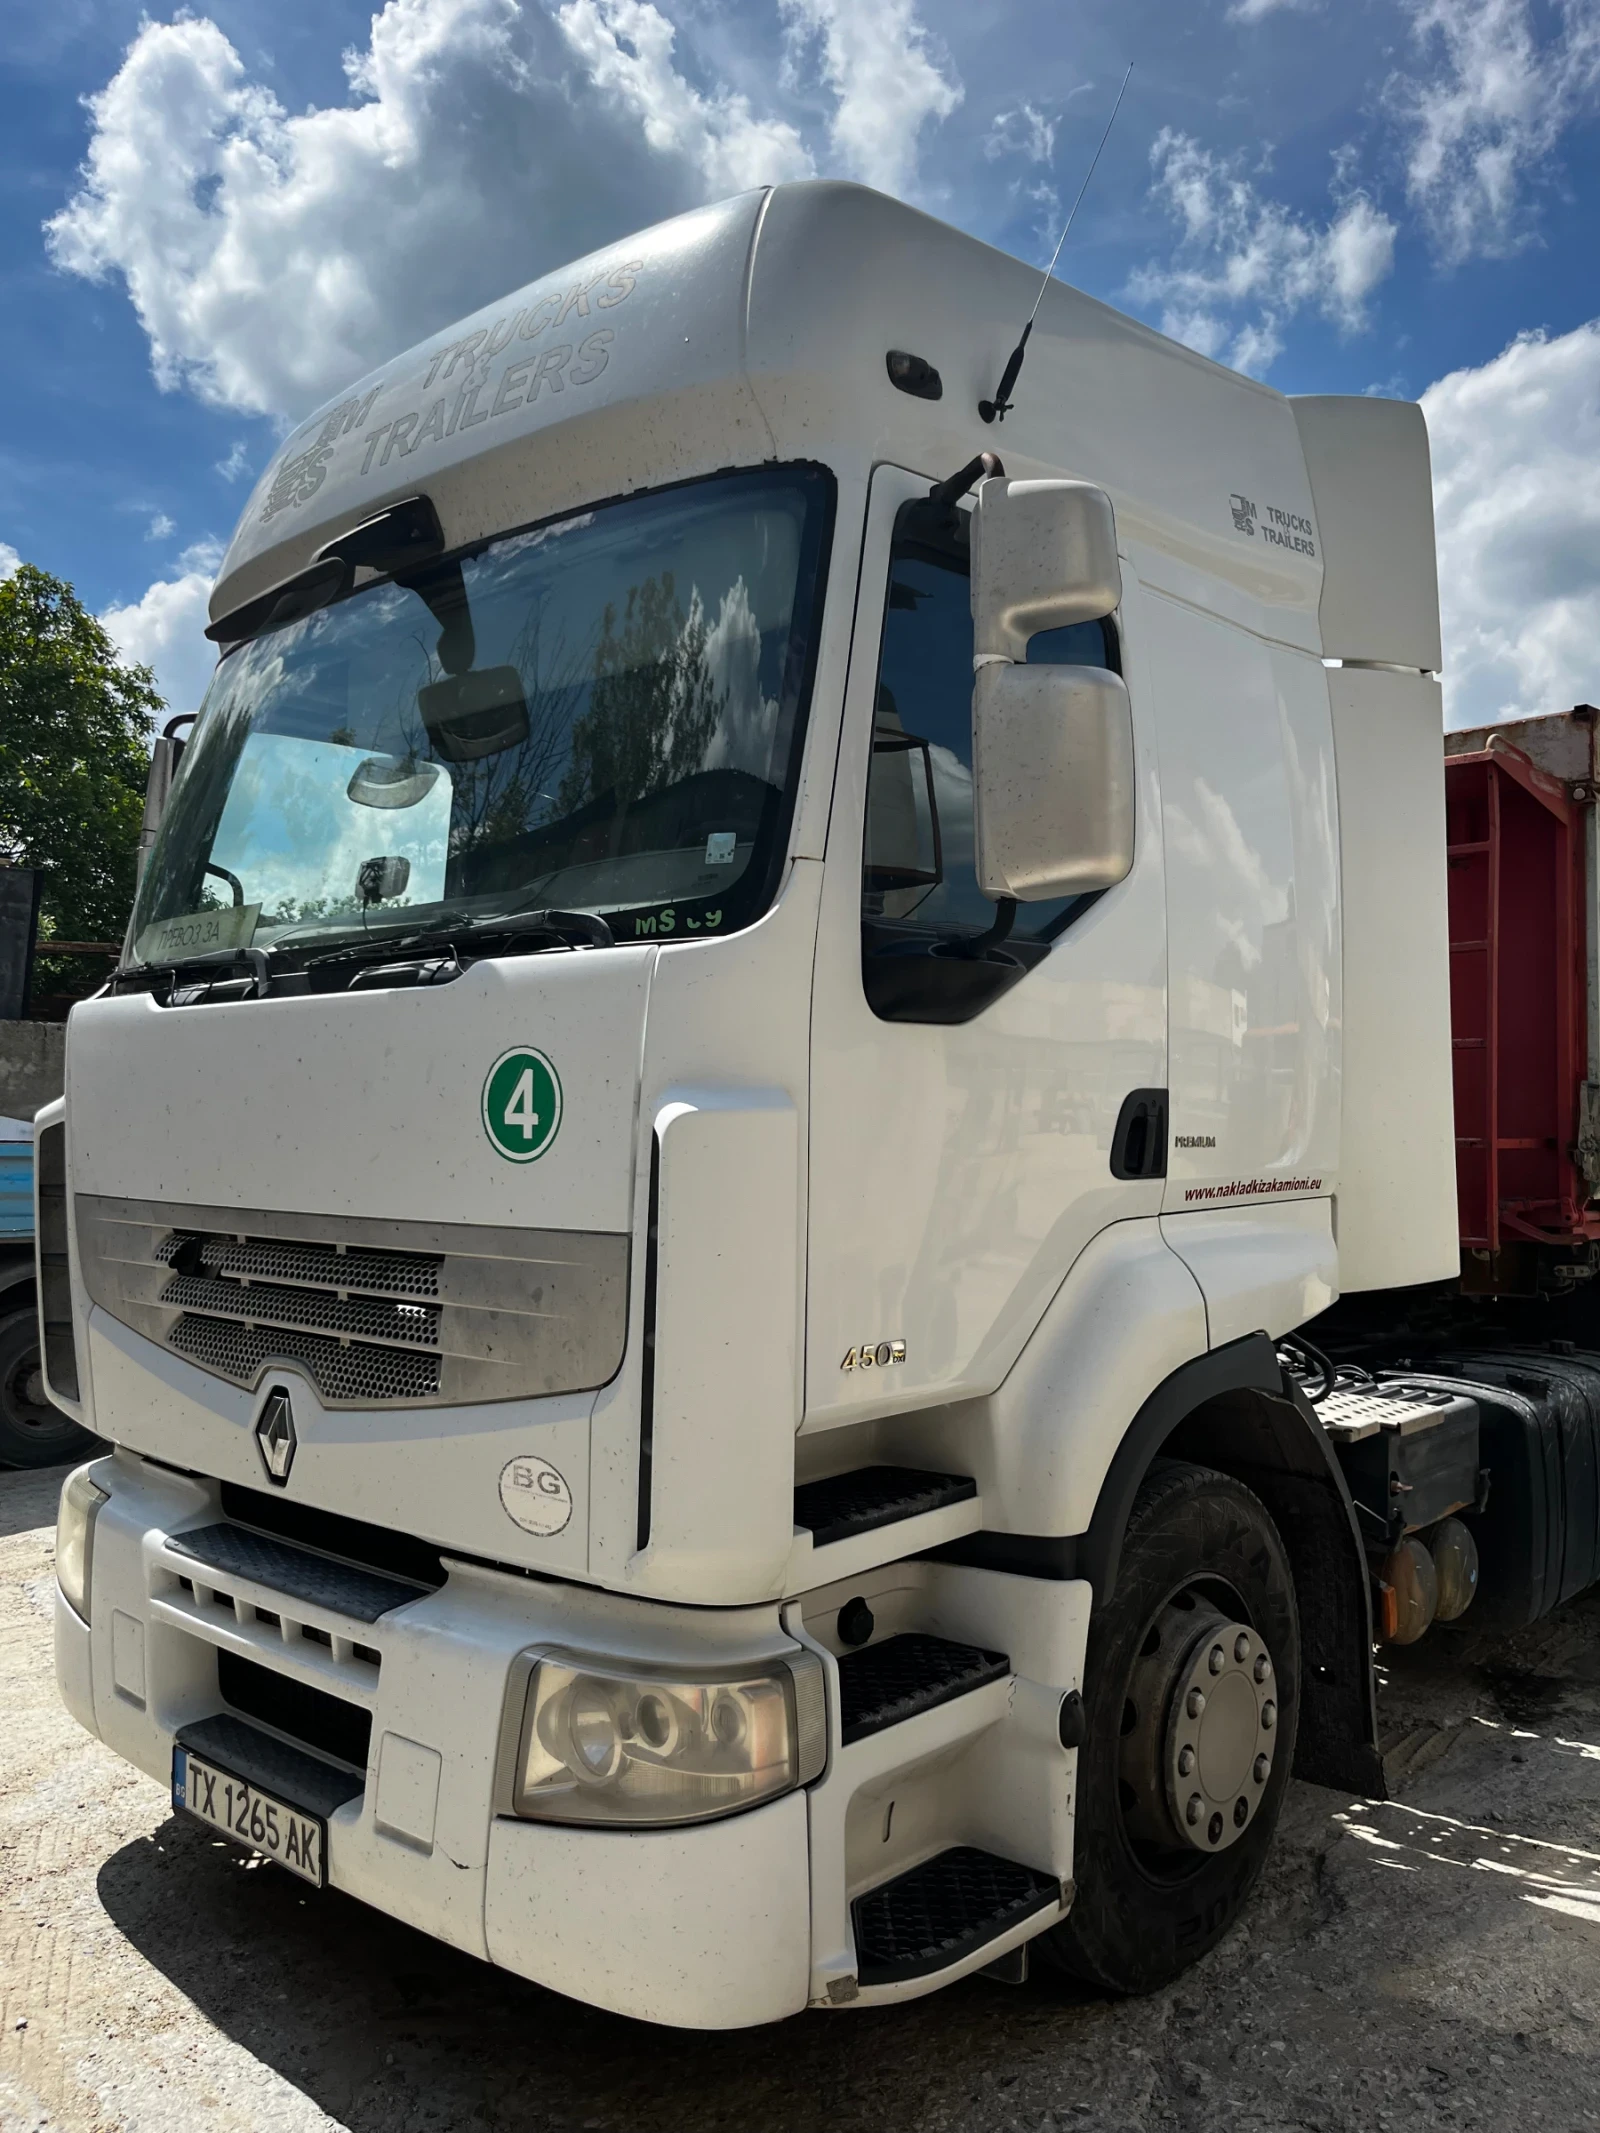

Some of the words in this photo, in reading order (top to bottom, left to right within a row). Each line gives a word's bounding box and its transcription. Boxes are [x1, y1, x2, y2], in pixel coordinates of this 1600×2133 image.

[423, 260, 643, 389] TRUCKS
[461, 351, 491, 396] &
[360, 328, 615, 476] TRAILERS
[1266, 505, 1312, 536] TRUCKS
[1261, 525, 1315, 557] TRAILERS
[157, 923, 200, 951] ПРЕВОЗ
[202, 920, 220, 944] ЗА
[504, 1068, 539, 1139] 4
[1174, 1135, 1216, 1148] PREMIUM
[1185, 1176, 1322, 1201] www.nakladkizakamioni.eu
[840, 1341, 891, 1371] 450
[513, 1464, 561, 1495] BG
[175, 1782, 186, 1799] BG
[189, 1763, 217, 1819] TX
[225, 1783, 280, 1850] 1265
[286, 1817, 317, 1876] AK
